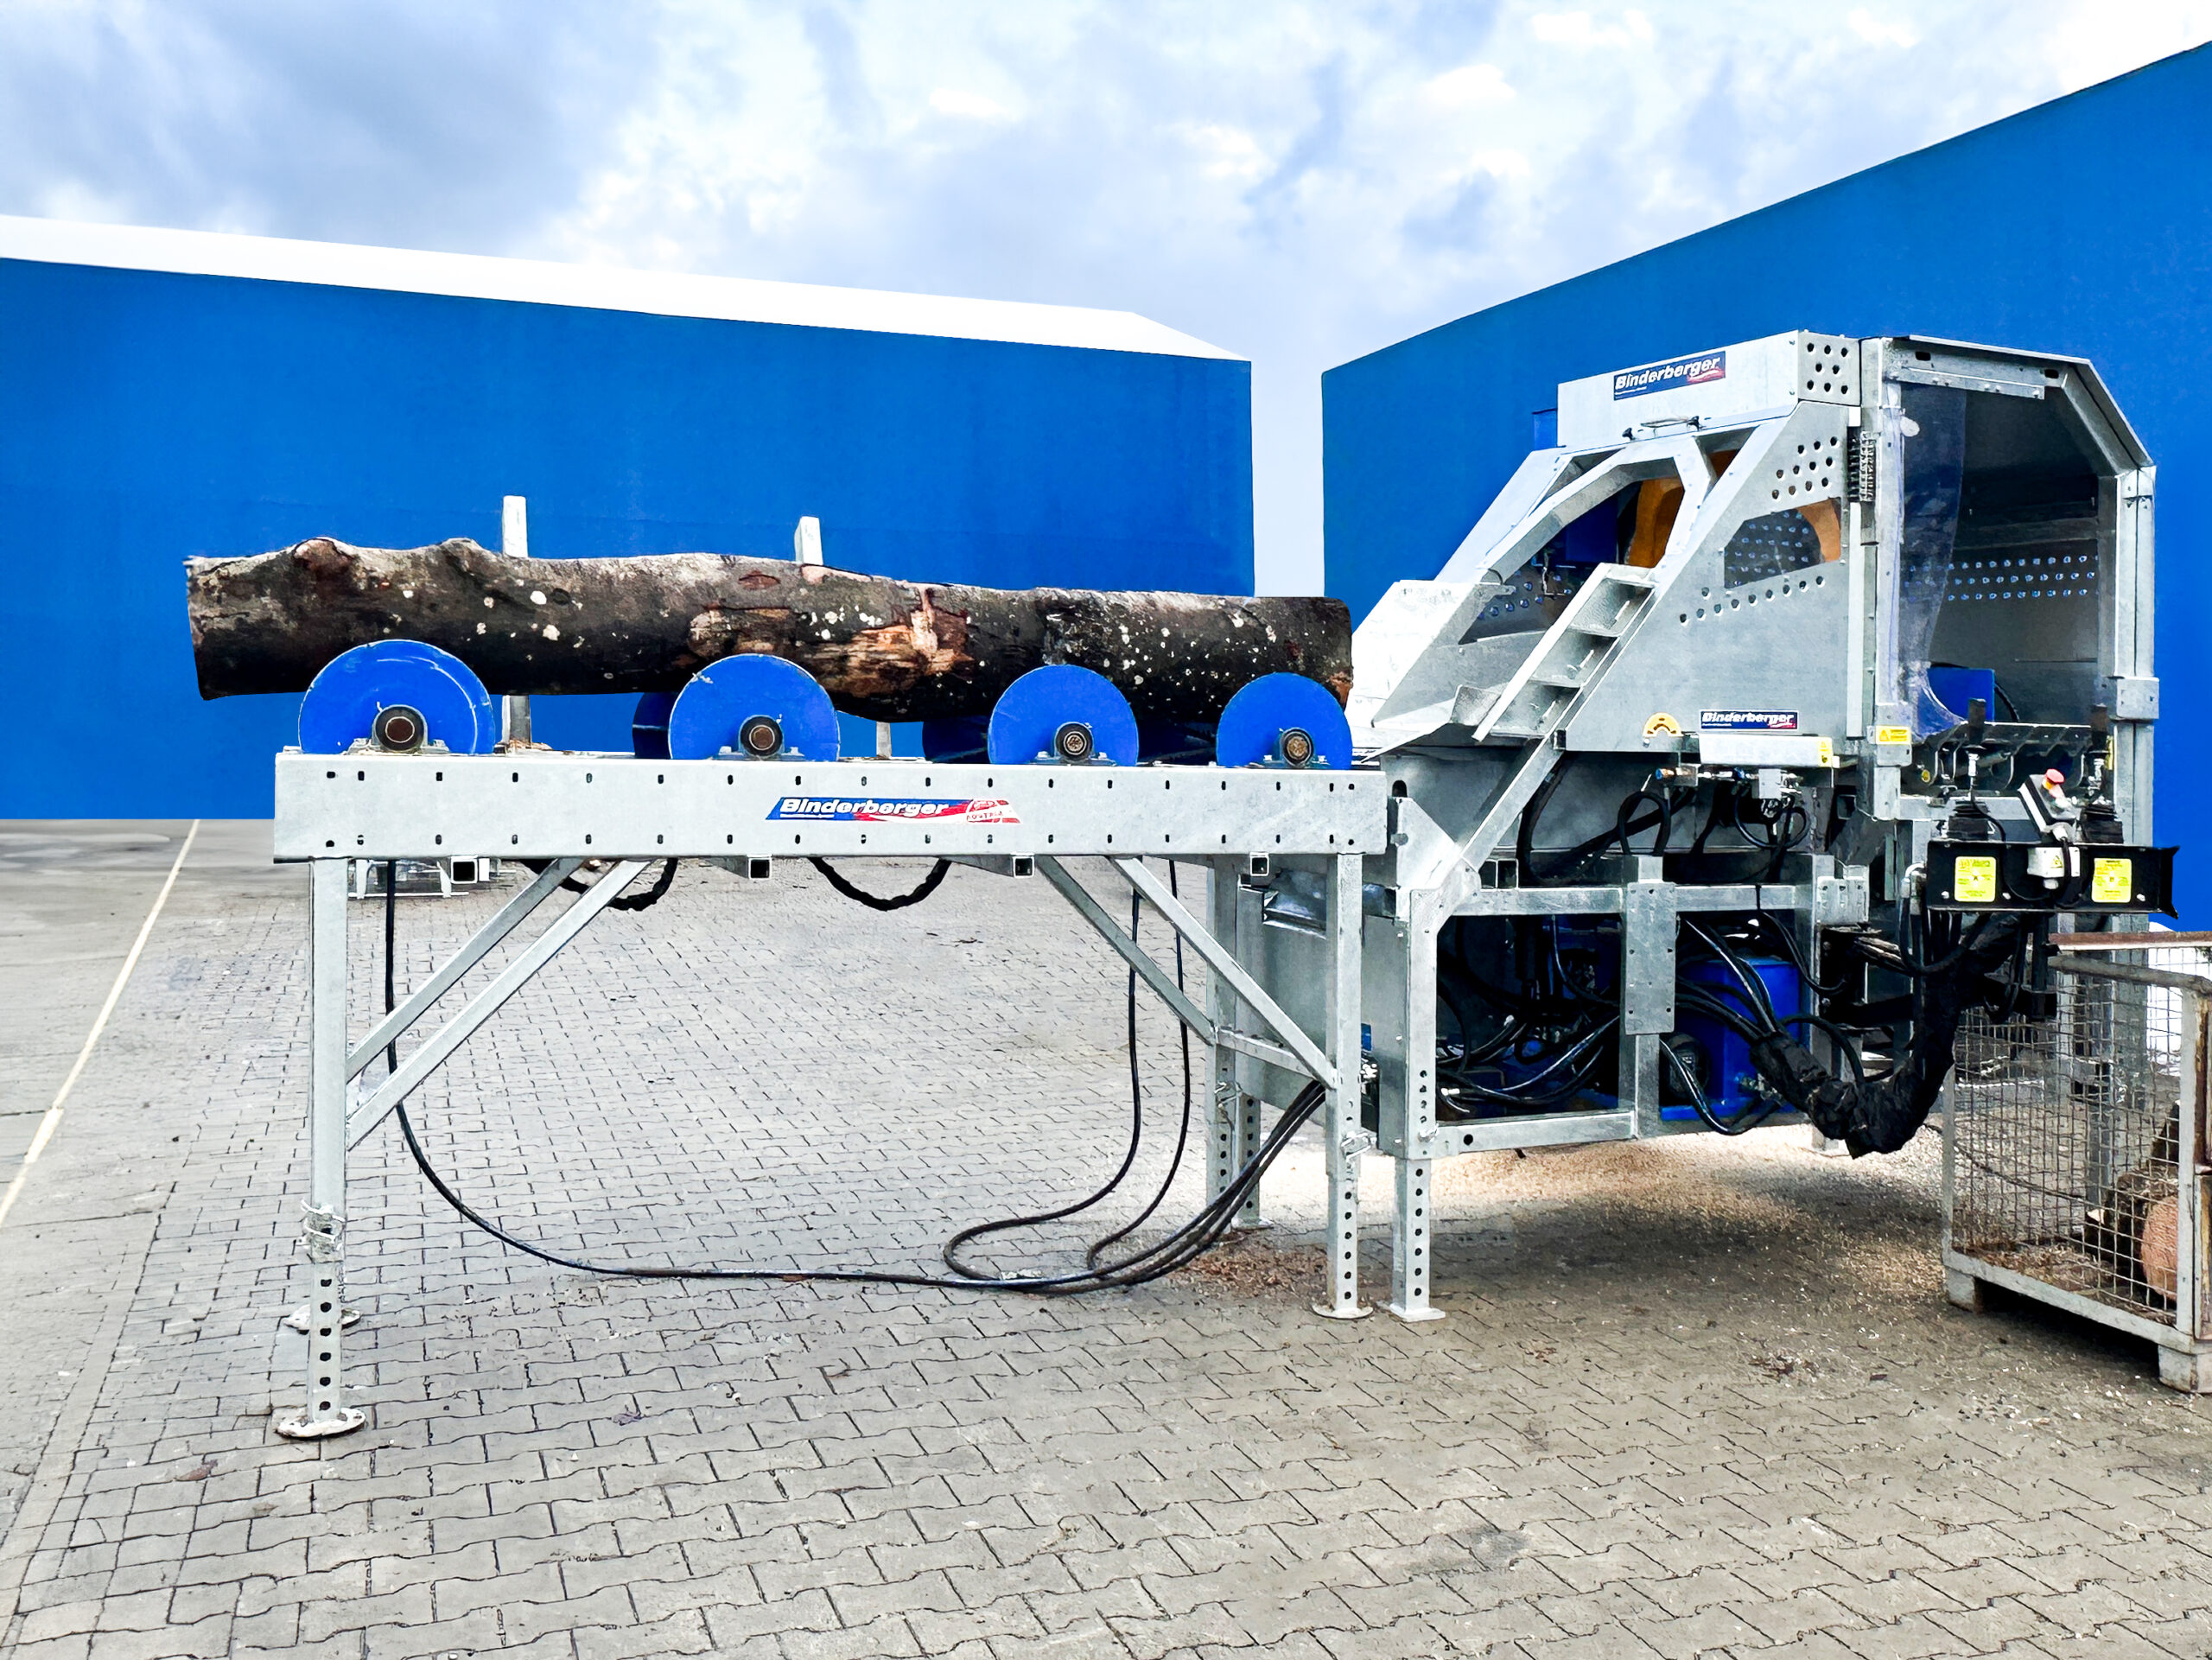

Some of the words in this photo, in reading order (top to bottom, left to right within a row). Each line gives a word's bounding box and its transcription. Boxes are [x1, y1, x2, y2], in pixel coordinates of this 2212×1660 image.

[1614, 357, 1720, 390] Binderberger
[1701, 711, 1795, 725] Binderberger
[779, 798, 949, 817] Binderberger
